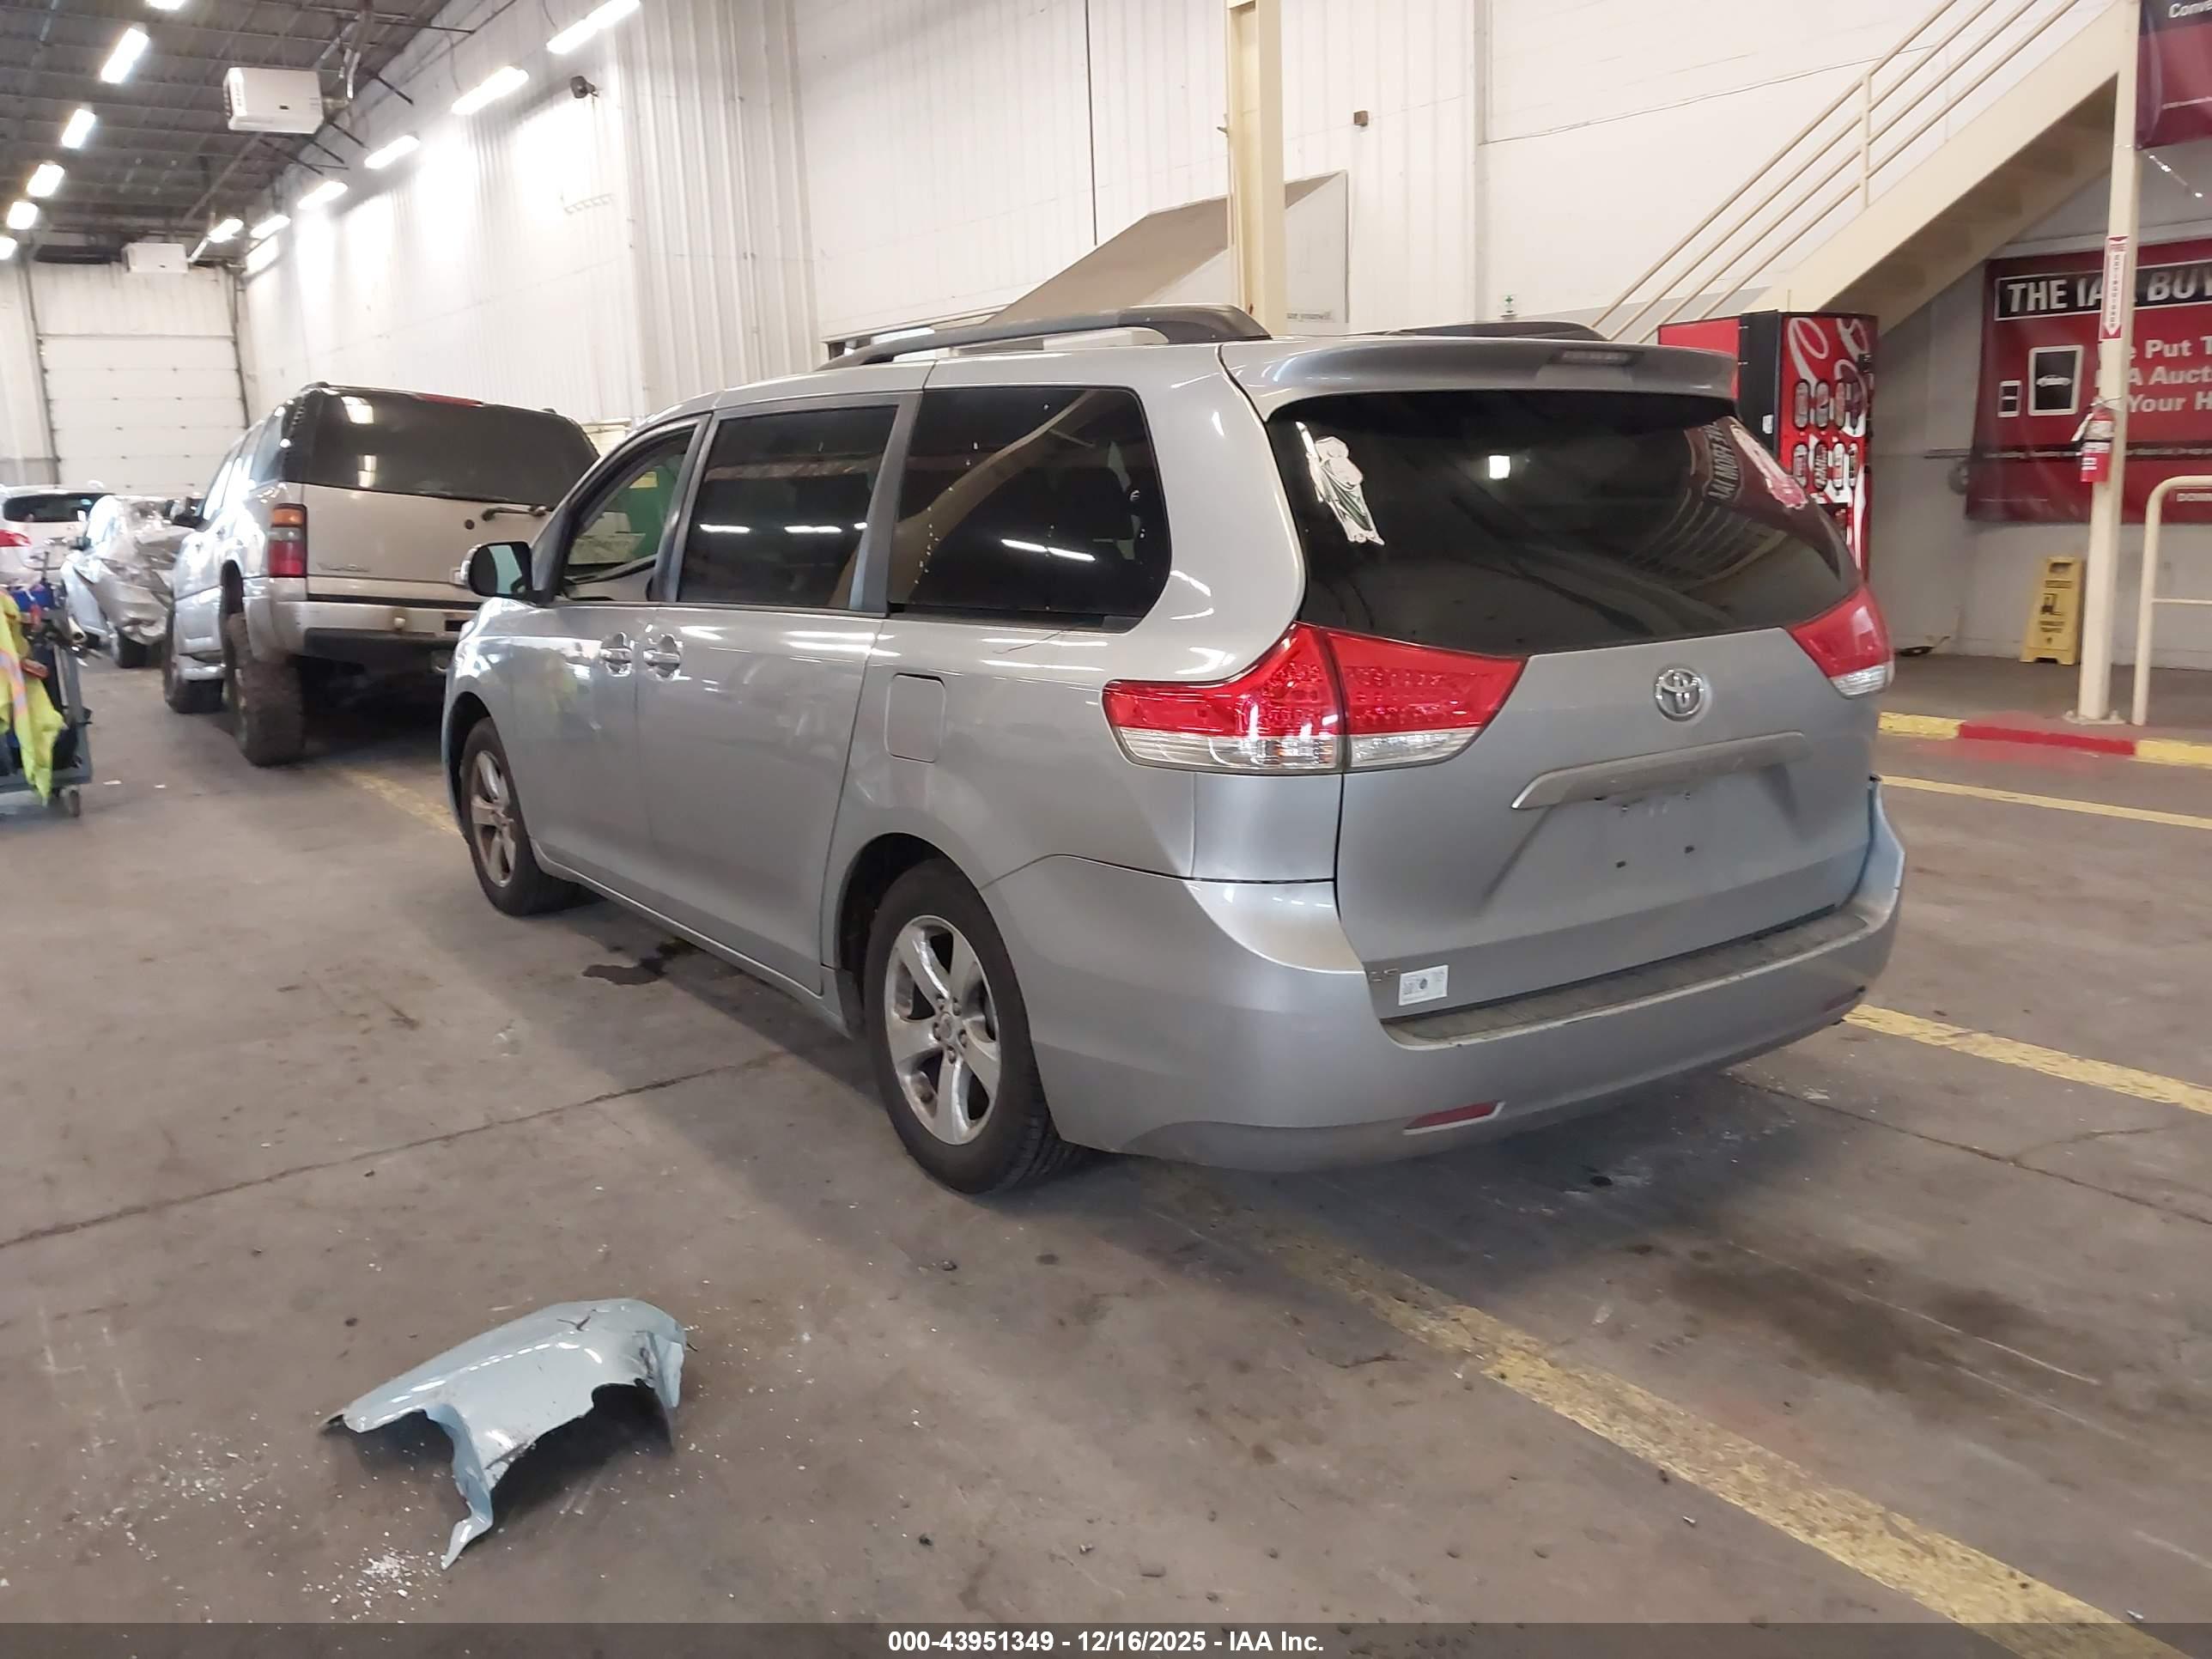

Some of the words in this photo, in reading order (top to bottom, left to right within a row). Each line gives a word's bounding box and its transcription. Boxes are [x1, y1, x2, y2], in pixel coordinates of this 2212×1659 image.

[2007, 279, 2068, 313] THE
[2145, 339, 2193, 358] Put
[2148, 366, 2212, 386] Auct
[2129, 394, 2187, 412] Your
